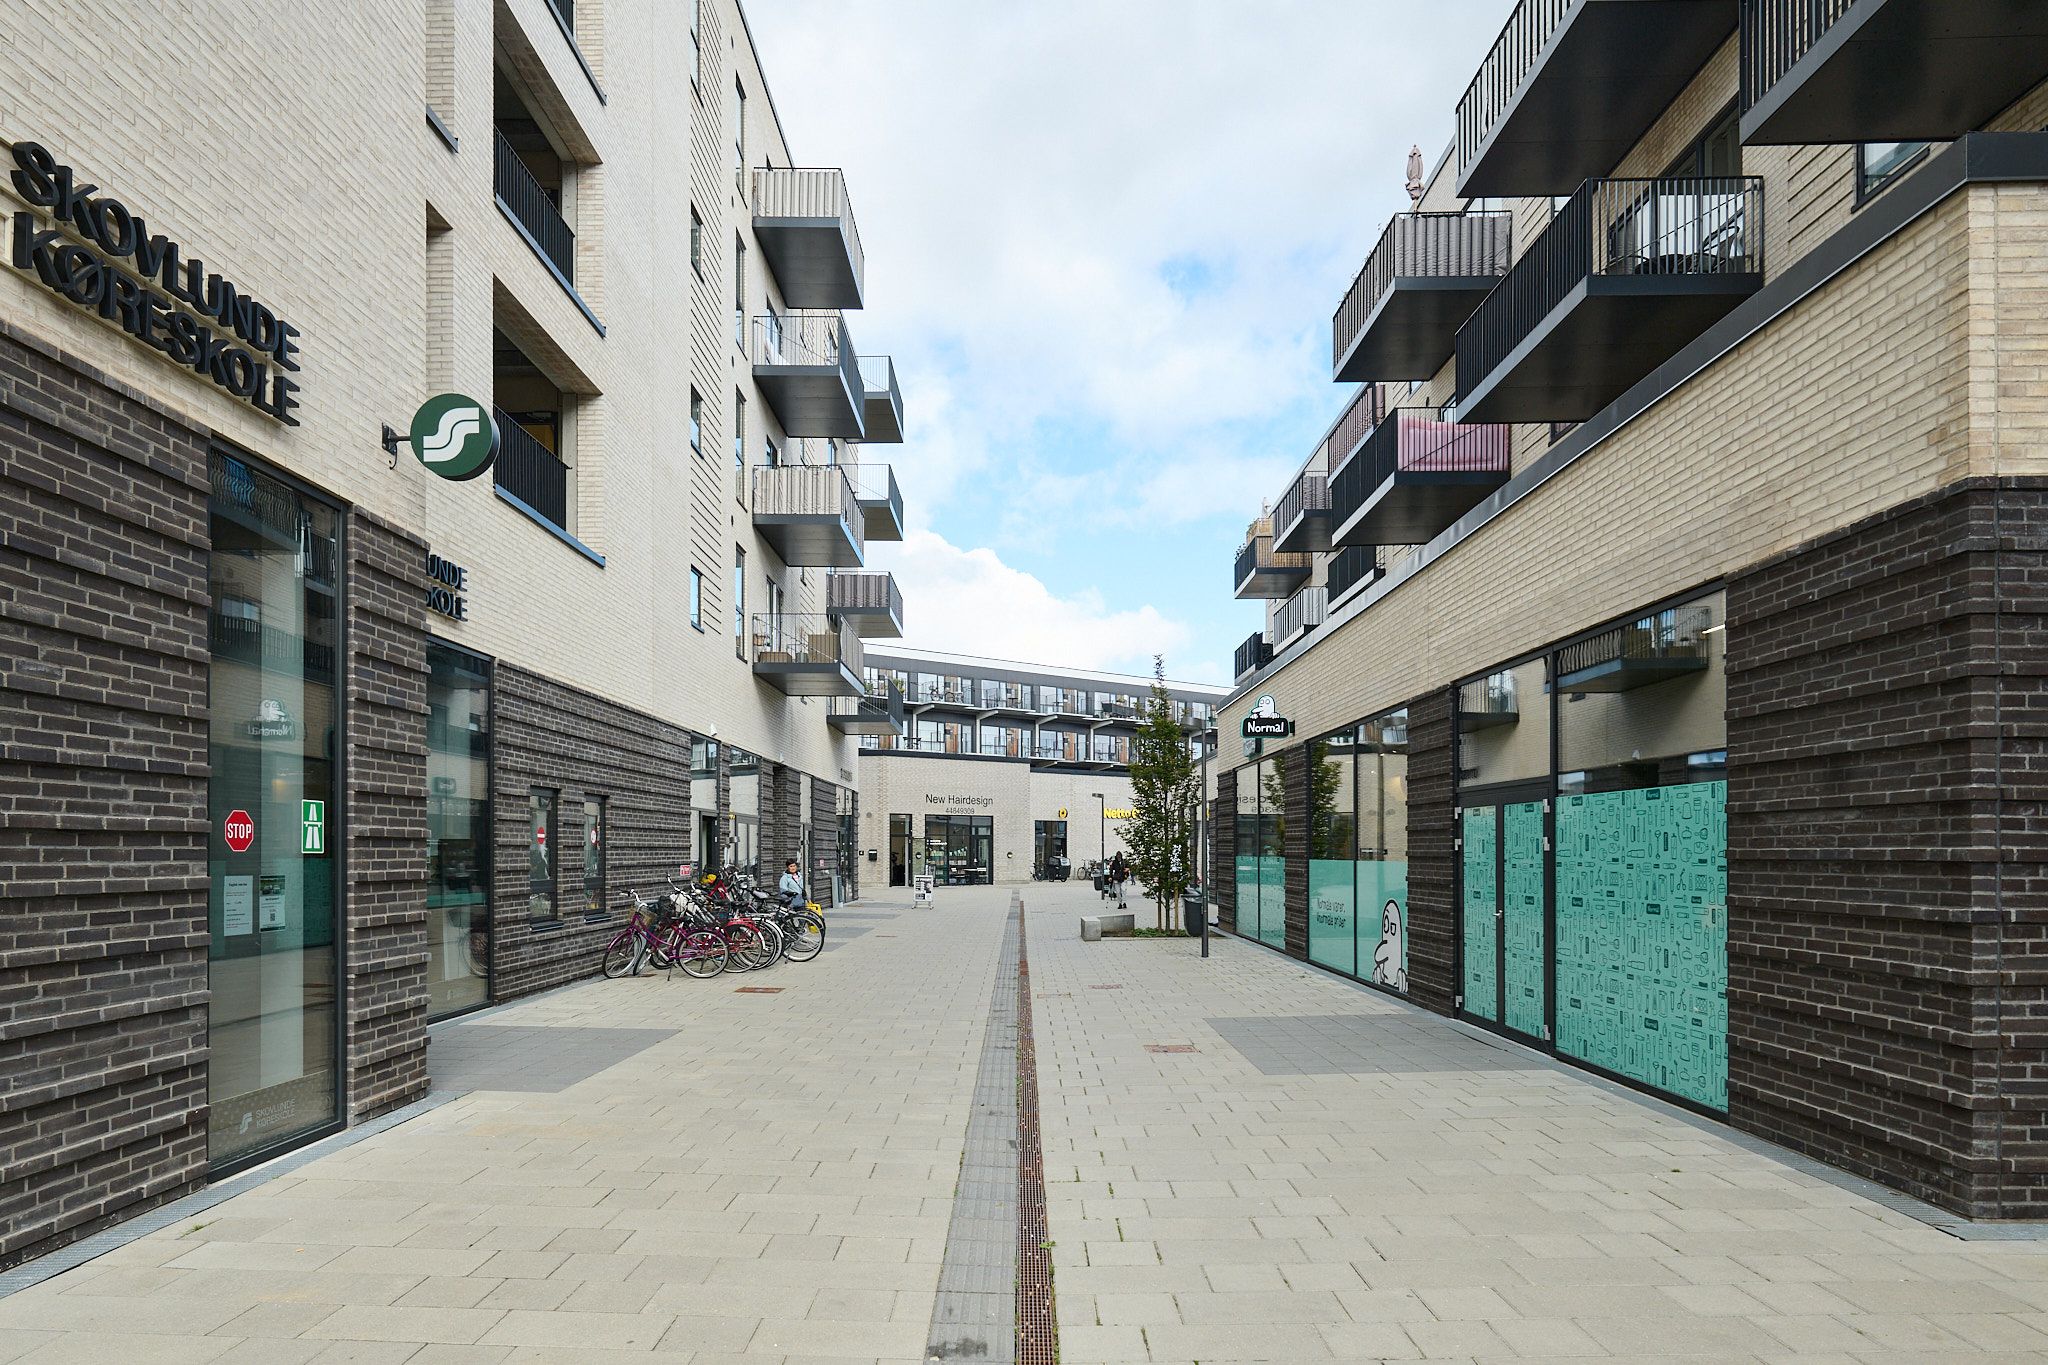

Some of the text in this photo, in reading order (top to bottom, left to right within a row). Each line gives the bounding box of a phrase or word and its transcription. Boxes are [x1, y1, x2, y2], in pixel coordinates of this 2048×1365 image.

[10, 141, 300, 371] SKOVLUNDE
[13, 212, 300, 427] KØRESKOLE
[1247, 720, 1285, 733] Normal
[925, 794, 994, 808] New Hairdesign
[1103, 808, 1131, 819] Netto
[227, 823, 252, 839] STOP
